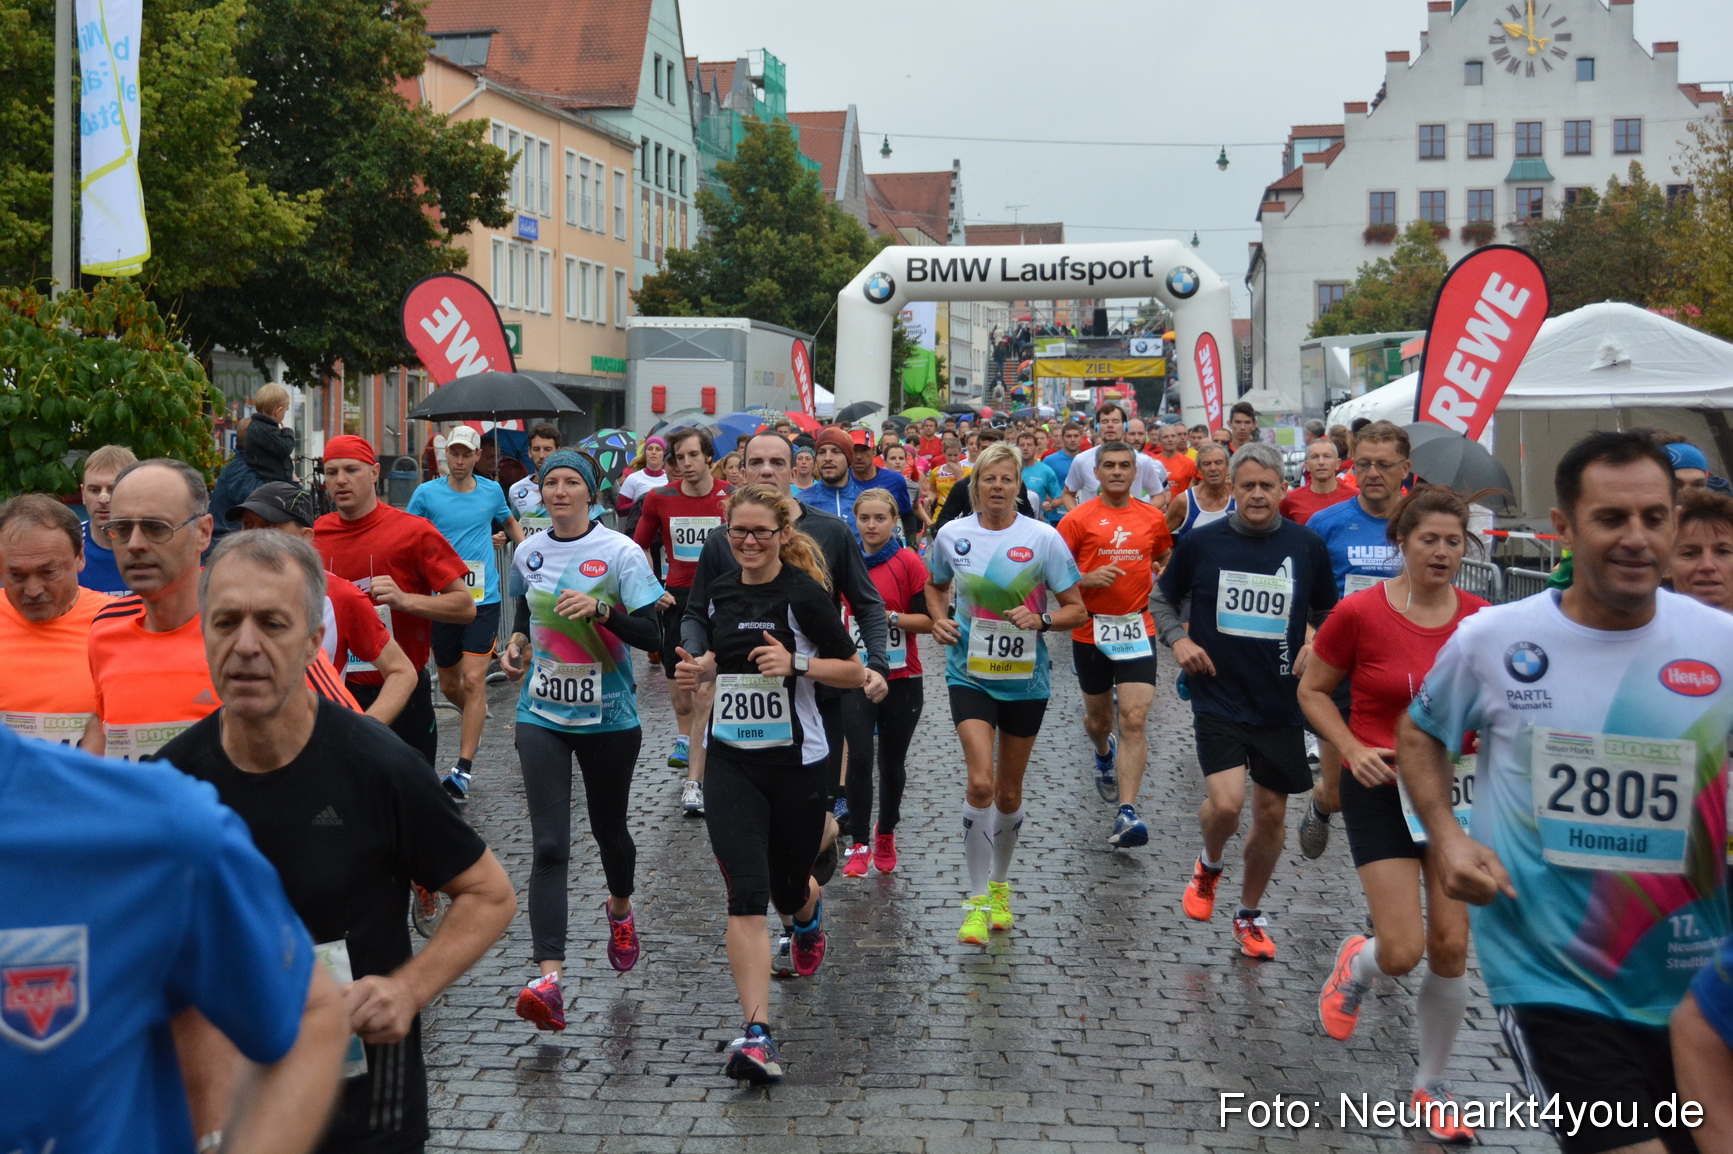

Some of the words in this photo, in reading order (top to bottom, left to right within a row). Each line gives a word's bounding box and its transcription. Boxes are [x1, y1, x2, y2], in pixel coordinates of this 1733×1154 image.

[906, 257, 992, 283] BMW
[1000, 255, 1154, 286] Laufsport
[1428, 272, 1530, 434] REWE
[1085, 363, 1115, 374] ZIEL
[676, 528, 714, 544] 304
[1011, 550, 1031, 559] Hervis
[1098, 548, 1139, 556] funrunners
[583, 563, 605, 573] Hervis
[1225, 587, 1285, 616] 3009
[1100, 621, 1142, 642] 2145
[984, 634, 1025, 658] 198
[1112, 645, 1135, 654] Robert
[990, 662, 1012, 672] Heidi
[536, 673, 595, 703] 3008
[1667, 668, 1715, 688] Hervis
[1506, 689, 1553, 701] PARTL
[721, 692, 782, 720] 2806
[1509, 701, 1553, 710] Neumarkt
[737, 727, 764, 738] Irene
[1545, 743, 1595, 756] NeuerMarkt
[1604, 738, 1682, 761] BOCK
[1547, 763, 1678, 822] 2805
[1569, 827, 1648, 854] Homaid
[1668, 913, 1700, 938] 17.
